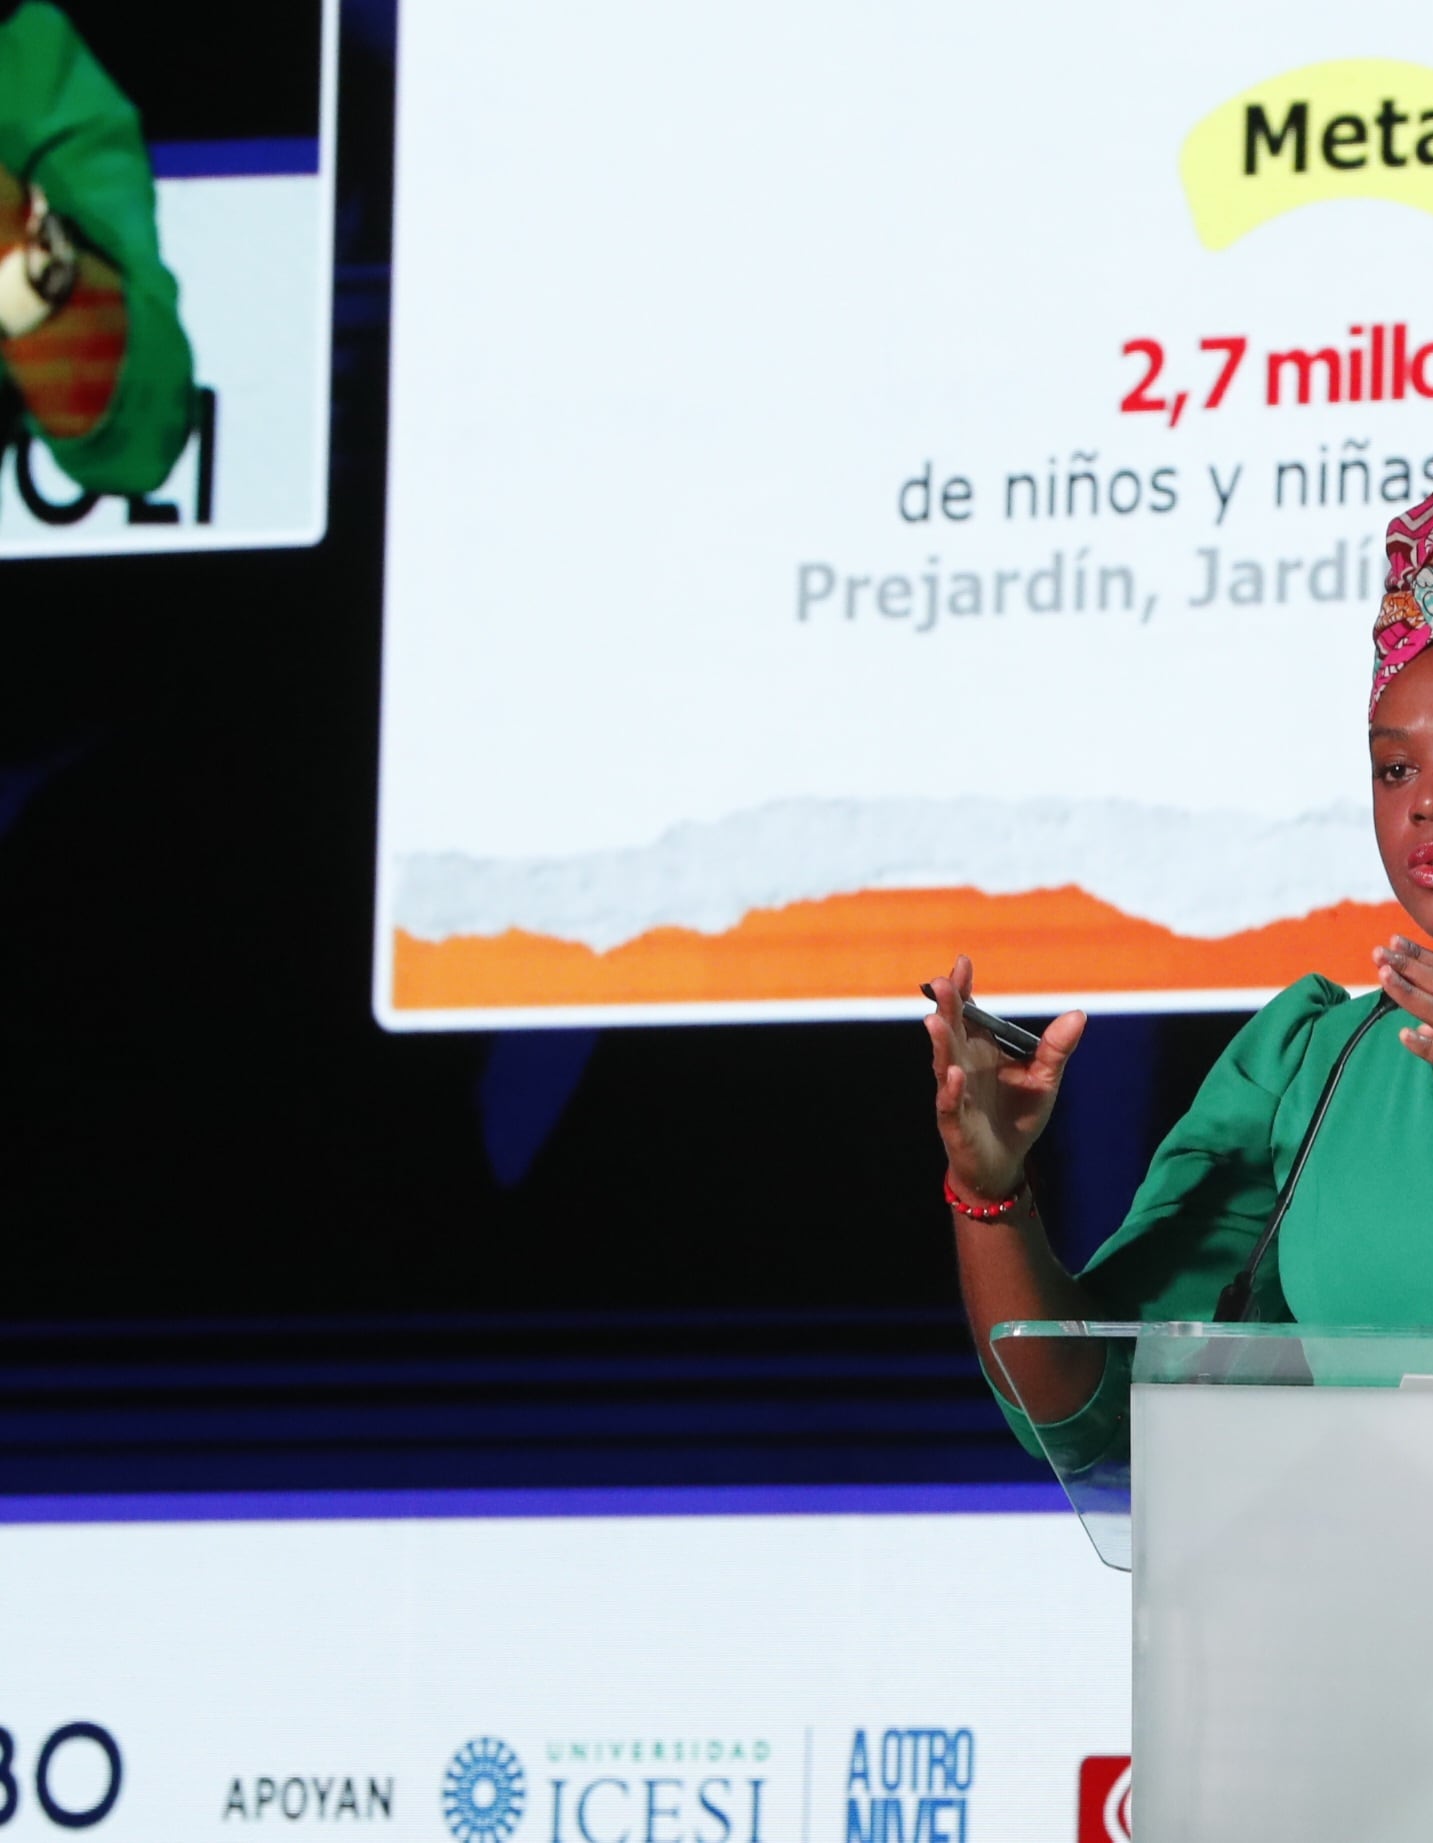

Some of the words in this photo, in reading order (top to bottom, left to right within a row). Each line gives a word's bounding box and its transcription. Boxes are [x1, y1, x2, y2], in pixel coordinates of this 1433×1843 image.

[1119, 336, 1248, 428] 2,7
[899, 461, 974, 524] de
[1005, 451, 1179, 520] niños
[1210, 464, 1242, 526] y
[796, 548, 1160, 634] Prejardín,
[1190, 536, 1386, 606] Jardí
[546, 1738, 771, 1763] UNIVERSIDAD
[849, 1728, 871, 1794] A
[881, 1728, 974, 1792] OTRO
[224, 1776, 394, 1821] APOYAN
[550, 1777, 765, 1843] ICESI
